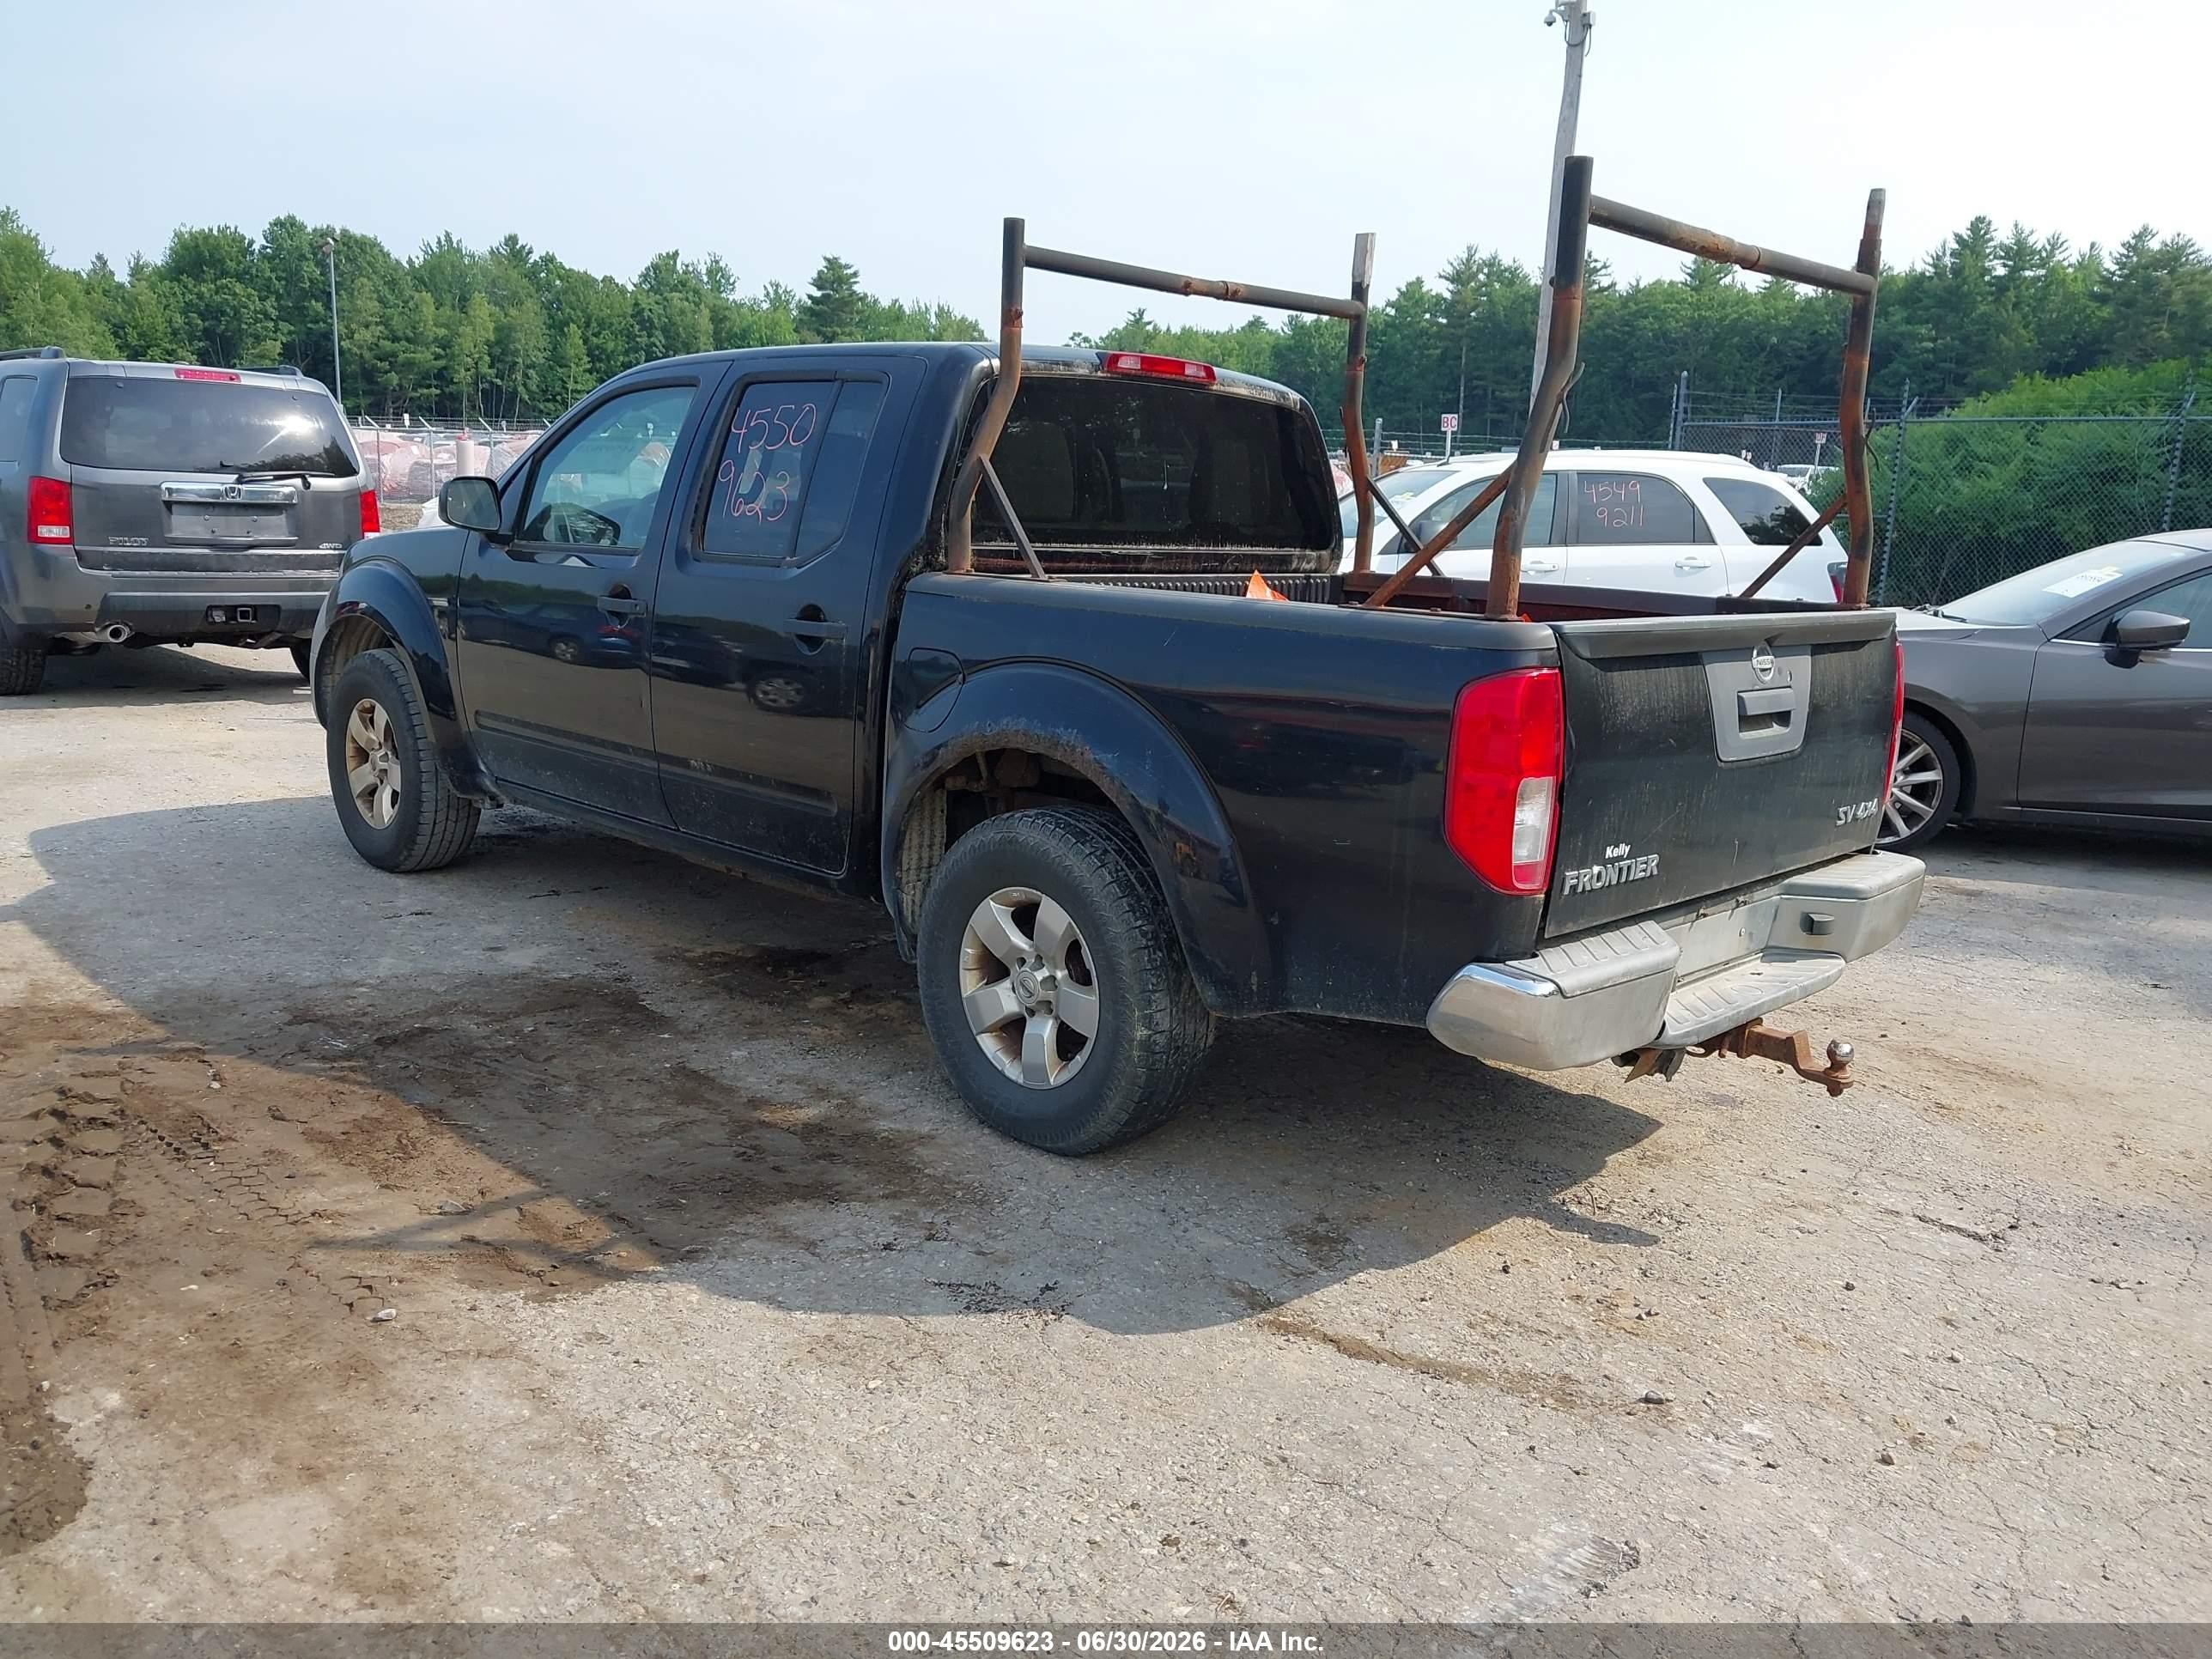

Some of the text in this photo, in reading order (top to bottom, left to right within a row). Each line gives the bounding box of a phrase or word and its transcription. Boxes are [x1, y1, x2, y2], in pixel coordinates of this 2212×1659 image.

[731, 403, 817, 453] 4550
[1443, 416, 1456, 428] BC
[718, 459, 790, 525] 9623
[1584, 480, 1640, 503] 4549
[1596, 504, 1643, 527] 9211
[108, 536, 149, 546] PILOT
[1836, 805, 1856, 825] SV
[1605, 842, 1631, 859] Kelly
[1564, 854, 1660, 895] FRONTIER
